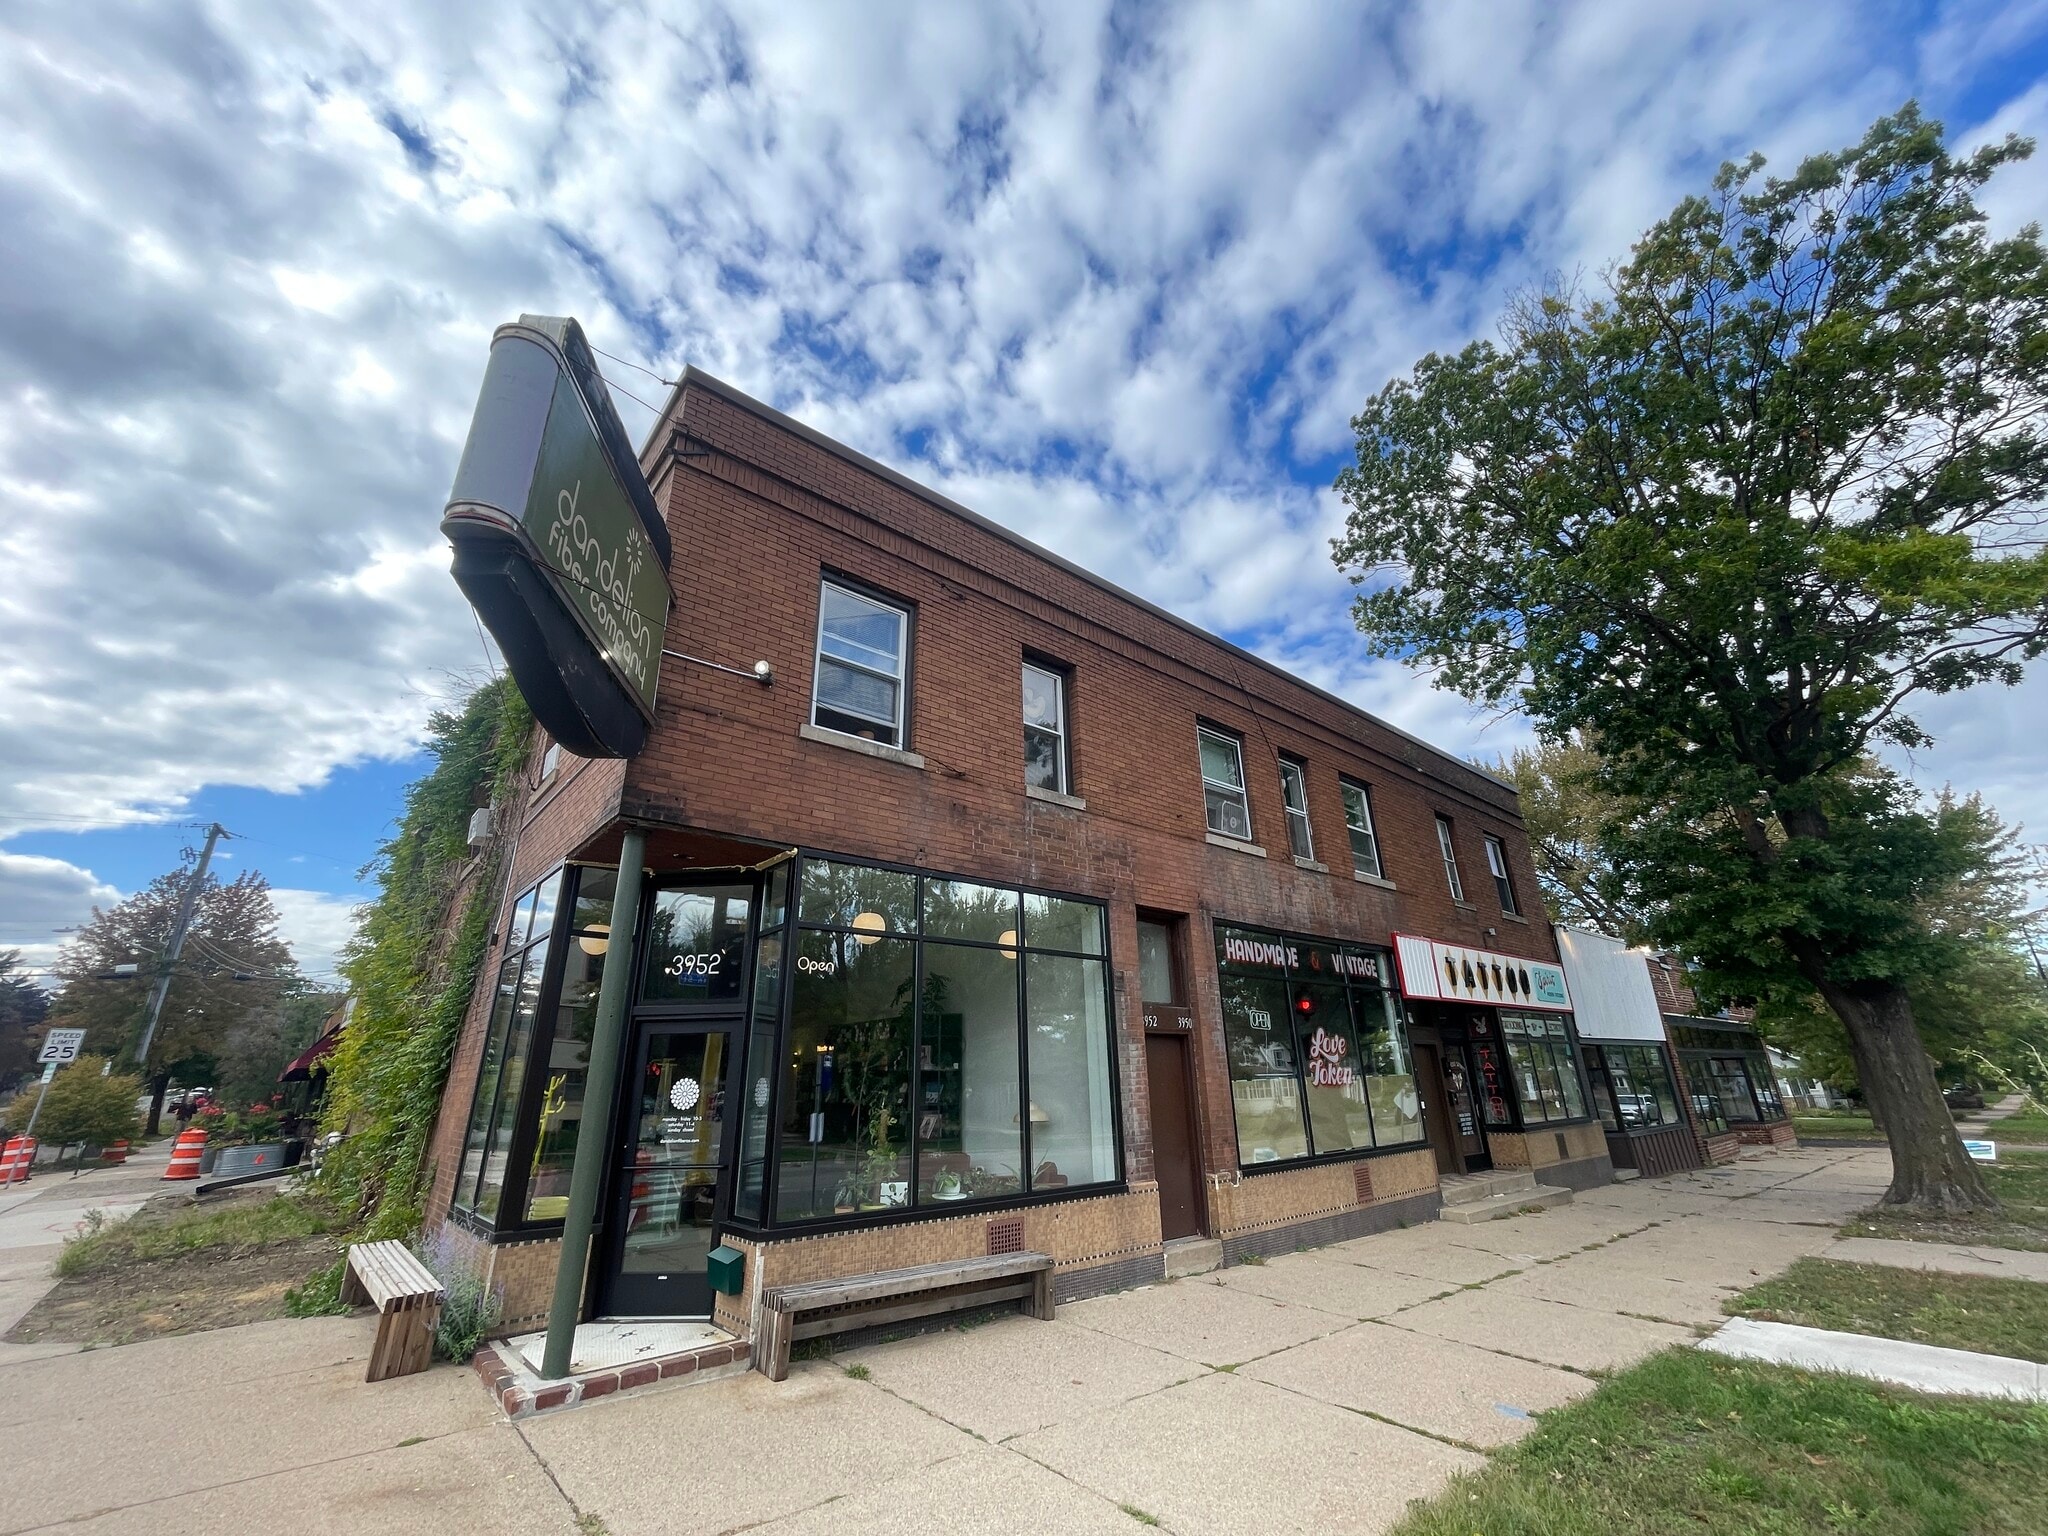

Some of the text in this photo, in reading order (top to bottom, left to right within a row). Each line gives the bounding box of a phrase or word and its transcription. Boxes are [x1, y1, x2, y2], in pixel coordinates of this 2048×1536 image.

[558, 480, 650, 658] dandelion
[590, 591, 646, 691] company
[672, 953, 721, 976] 3952
[797, 956, 835, 975] Open
[1444, 956, 1531, 995] TATTOO
[1142, 1015, 1158, 1027] 952
[1251, 1012, 1271, 1028] OPEN
[43, 1046, 75, 1059] 25
[1310, 1027, 1346, 1063] Love
[1309, 1059, 1353, 1087] Token
